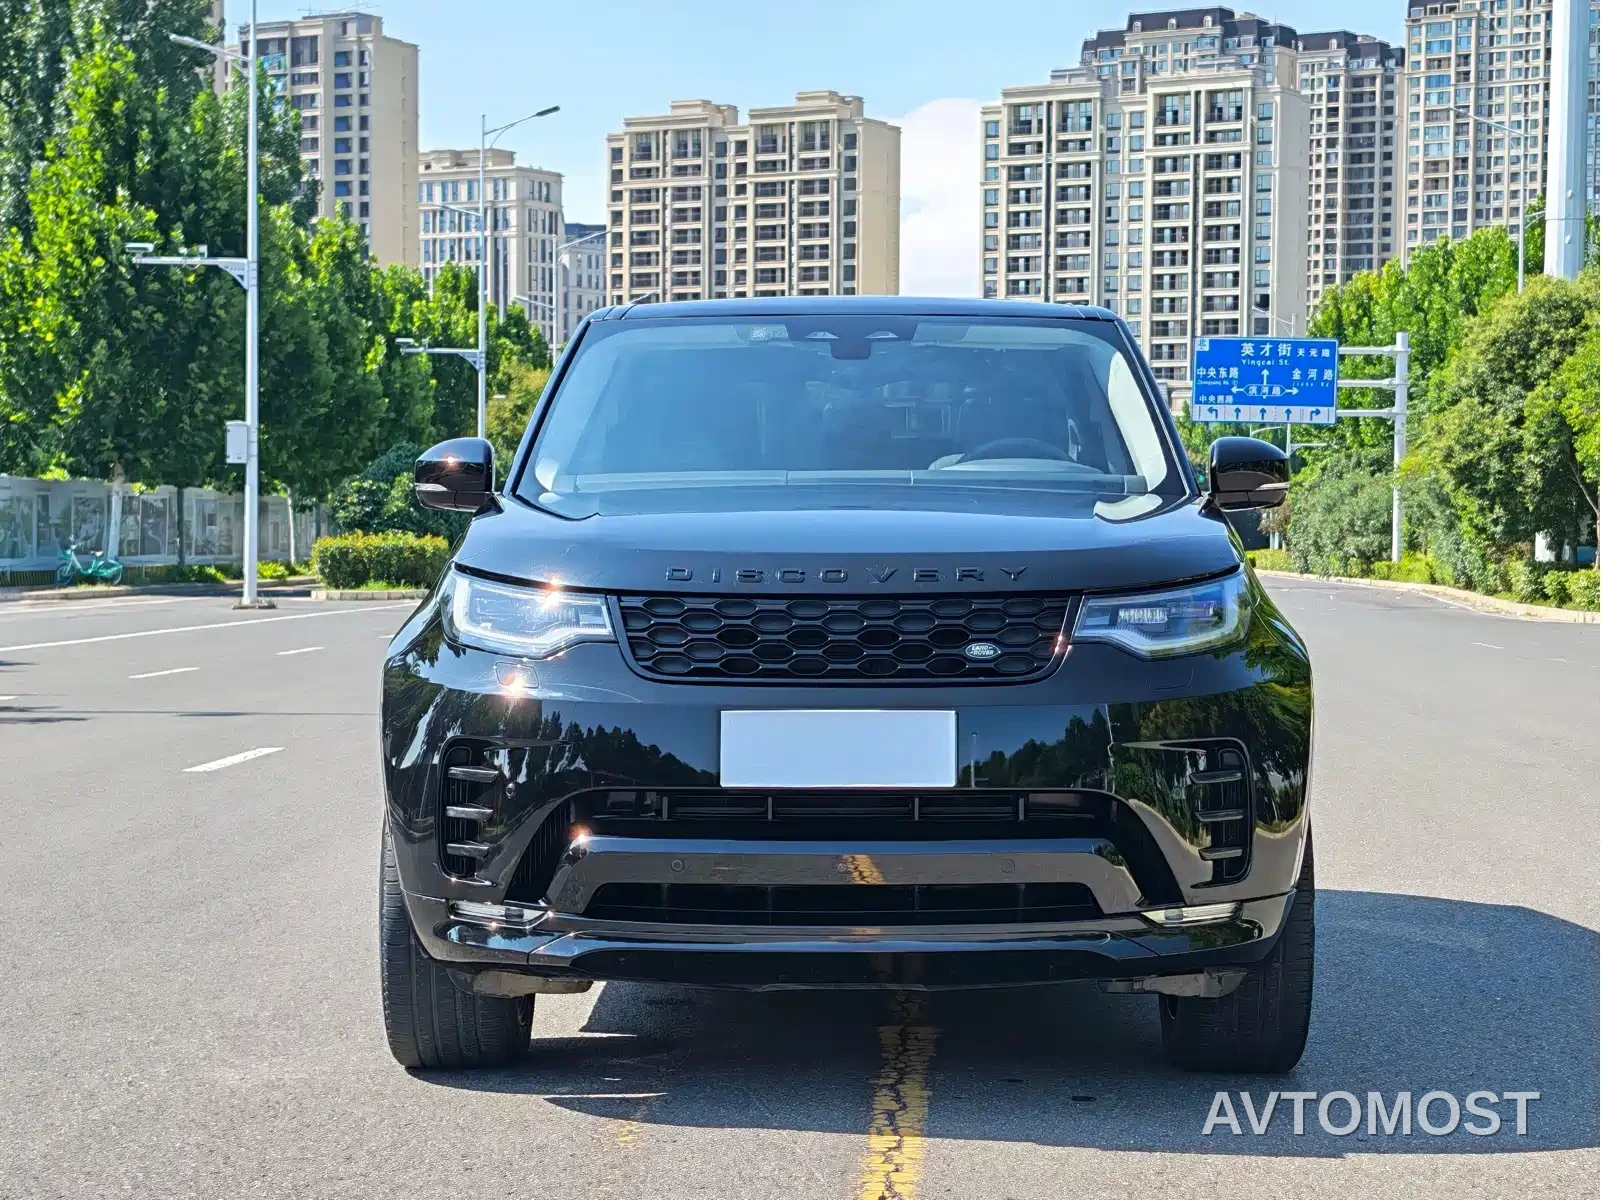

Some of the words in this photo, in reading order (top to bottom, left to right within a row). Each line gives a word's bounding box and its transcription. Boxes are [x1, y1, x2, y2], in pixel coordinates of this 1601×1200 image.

[1240, 342, 1292, 357] 英才街
[1296, 348, 1331, 358] 天元路
[1241, 359, 1275, 367] Yingcai
[1197, 366, 1239, 379] 中央东路
[1291, 367, 1333, 381] 金河路
[1199, 394, 1234, 404] 中央西路
[665, 565, 1029, 584] DISCOVERY
